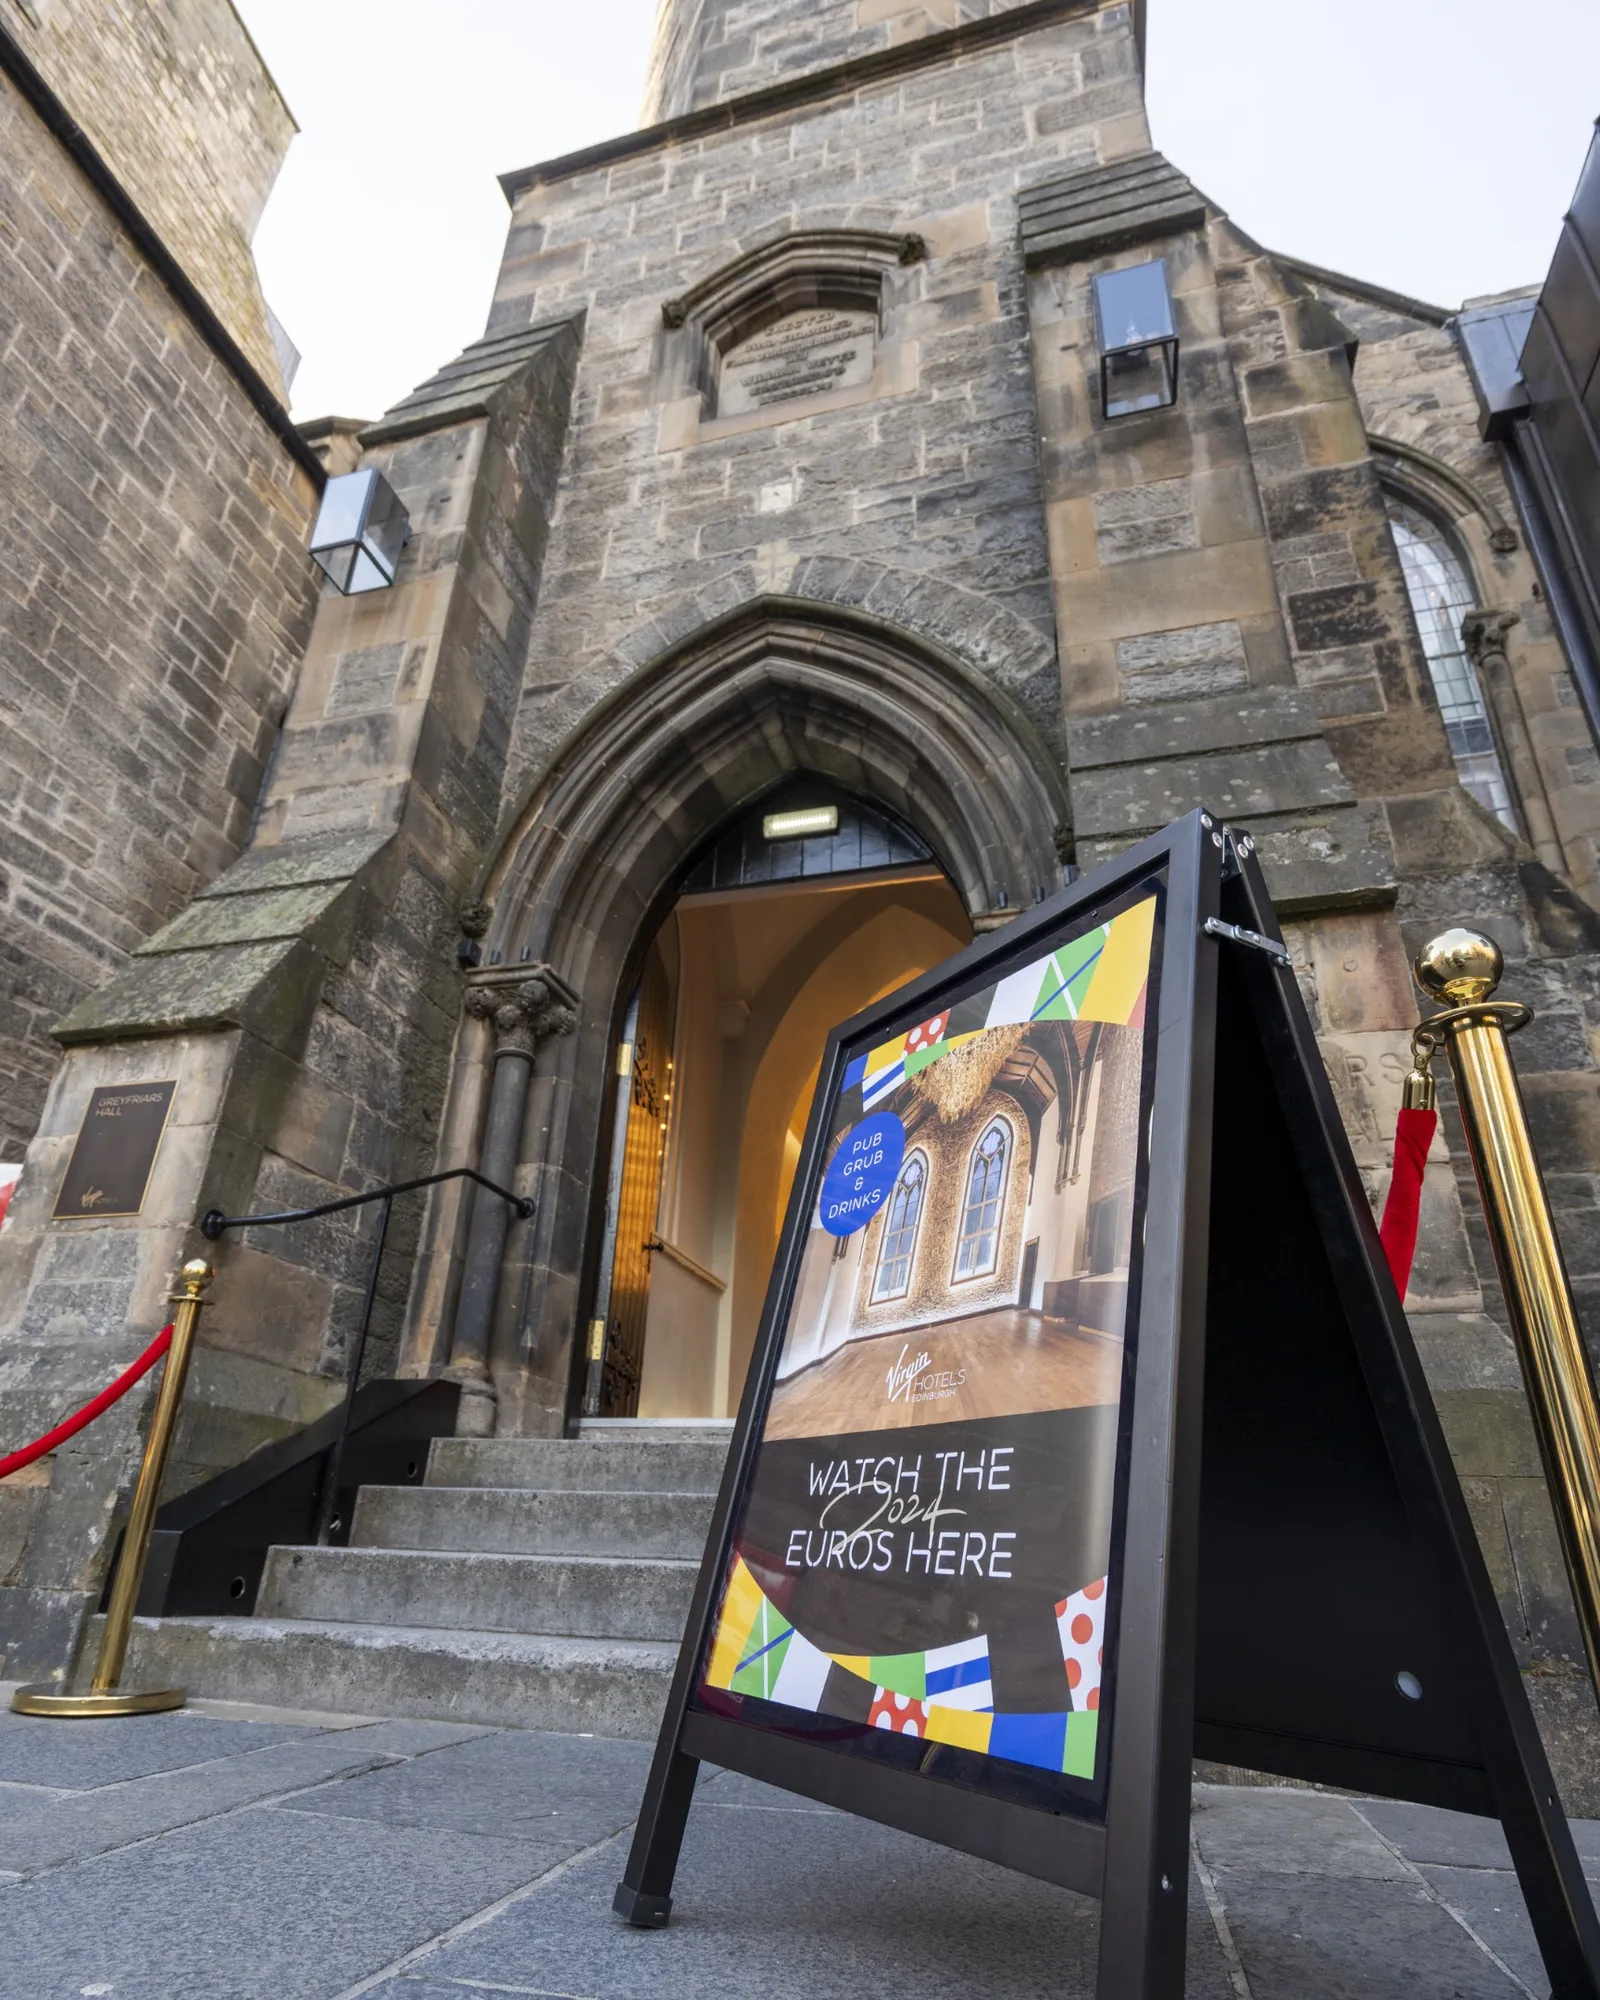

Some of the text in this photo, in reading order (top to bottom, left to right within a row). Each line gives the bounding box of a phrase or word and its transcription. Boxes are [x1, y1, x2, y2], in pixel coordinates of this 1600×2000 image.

[94, 1106, 122, 1117] HALL
[98, 1092, 164, 1107] GREYFRIARS
[852, 1132, 883, 1155] PUB
[843, 1150, 884, 1176] GRUB
[854, 1176, 864, 1191] &
[828, 1188, 881, 1219] DRINKS
[885, 1343, 967, 1403] Virgin HOTELS
[911, 1388, 957, 1403] EDINBURGH
[808, 1447, 1014, 1496] WATCH THE
[819, 1480, 967, 1552] 2024
[785, 1530, 1017, 1578] EUROS HERE
